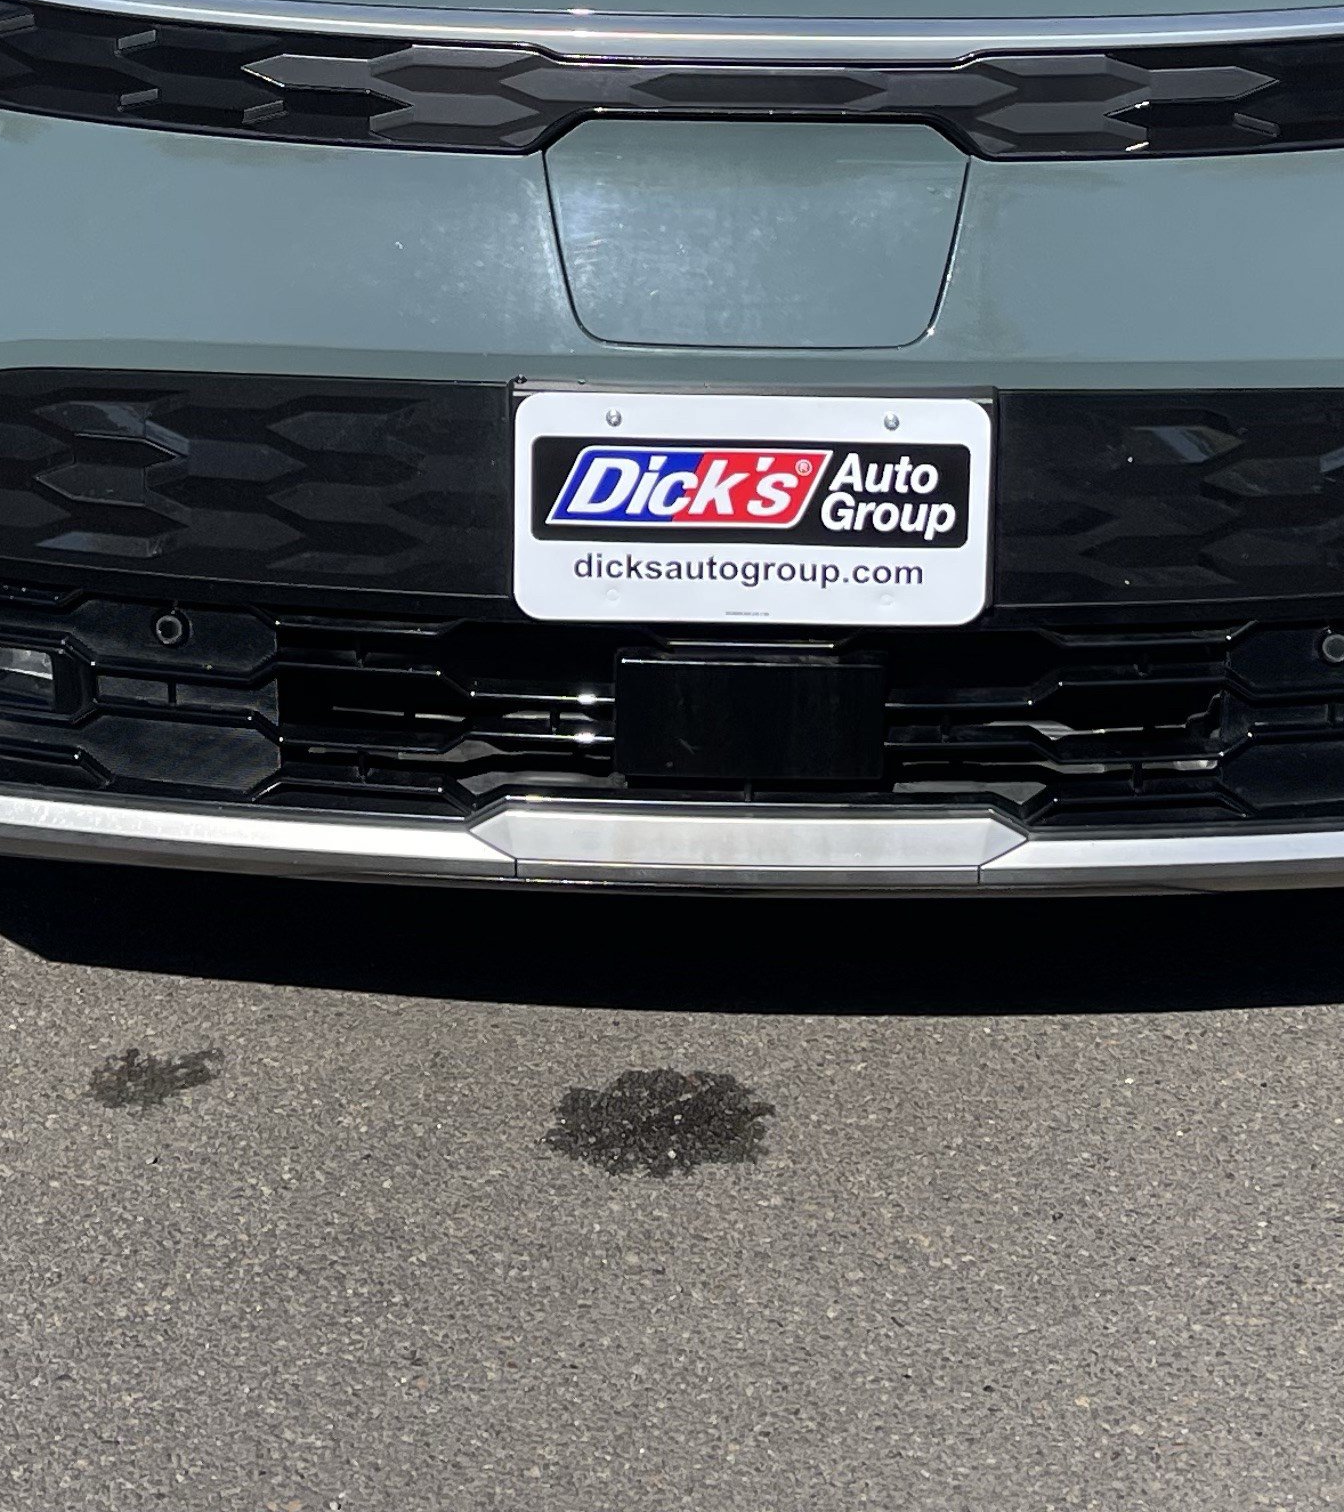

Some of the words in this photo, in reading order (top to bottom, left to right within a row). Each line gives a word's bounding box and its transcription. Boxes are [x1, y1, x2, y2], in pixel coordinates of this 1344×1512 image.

[566, 455, 799, 517] Dick's
[828, 452, 939, 495] Auto
[820, 493, 956, 541] Group
[573, 553, 924, 588] dicksautogroup.com
